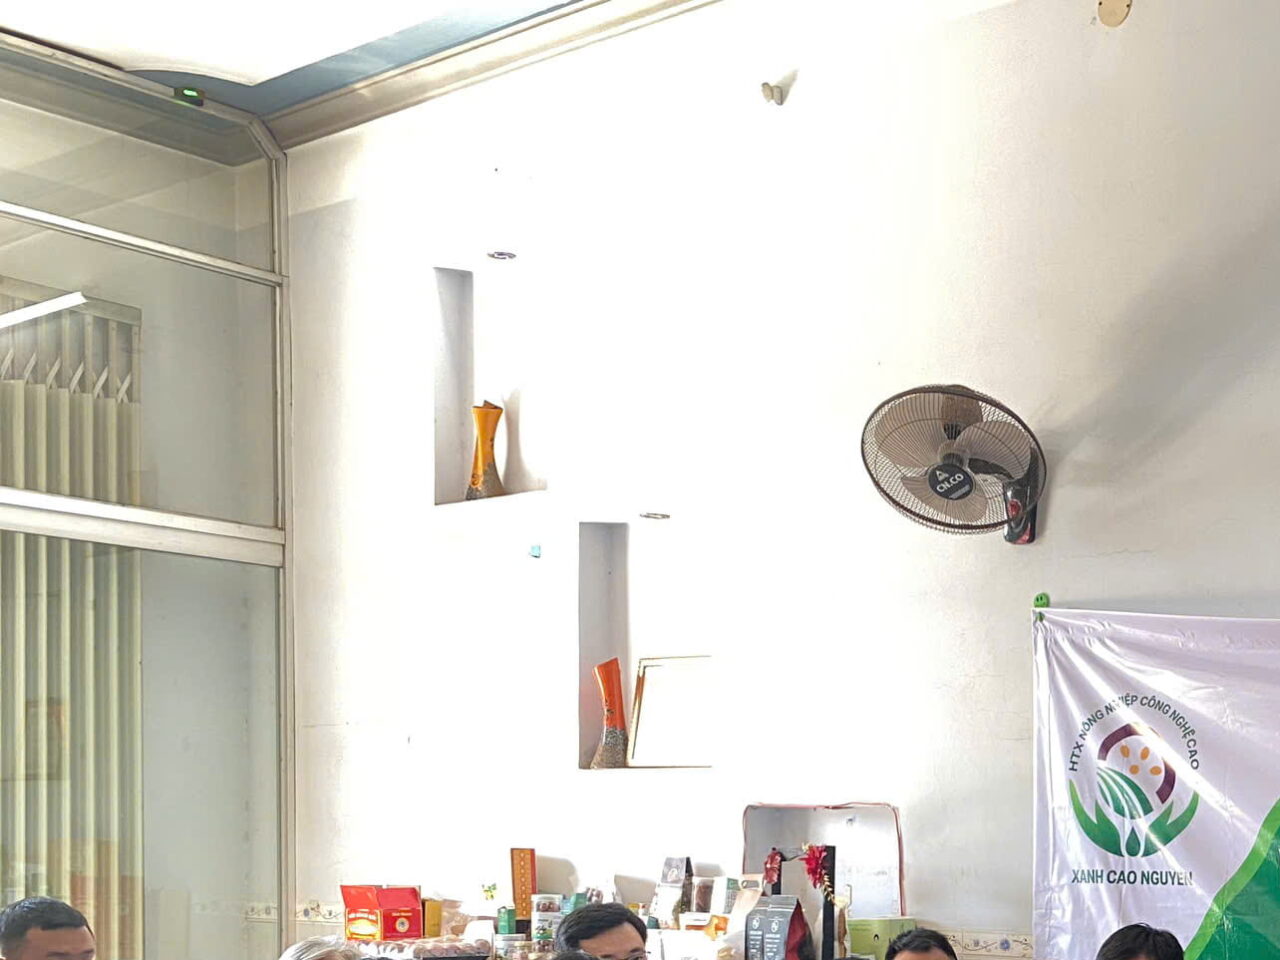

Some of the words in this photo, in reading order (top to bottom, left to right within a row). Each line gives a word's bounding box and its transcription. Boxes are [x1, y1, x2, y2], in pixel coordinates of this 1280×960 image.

[1069, 741, 1084, 772] HTX
[1079, 709, 1104, 740] NÔNG
[1140, 695, 1171, 715] CÔNG
[1169, 710, 1196, 740] NGHỆ
[1187, 738, 1200, 770] CAO
[1072, 869, 1104, 884] XANH
[1107, 870, 1137, 885] CAO
